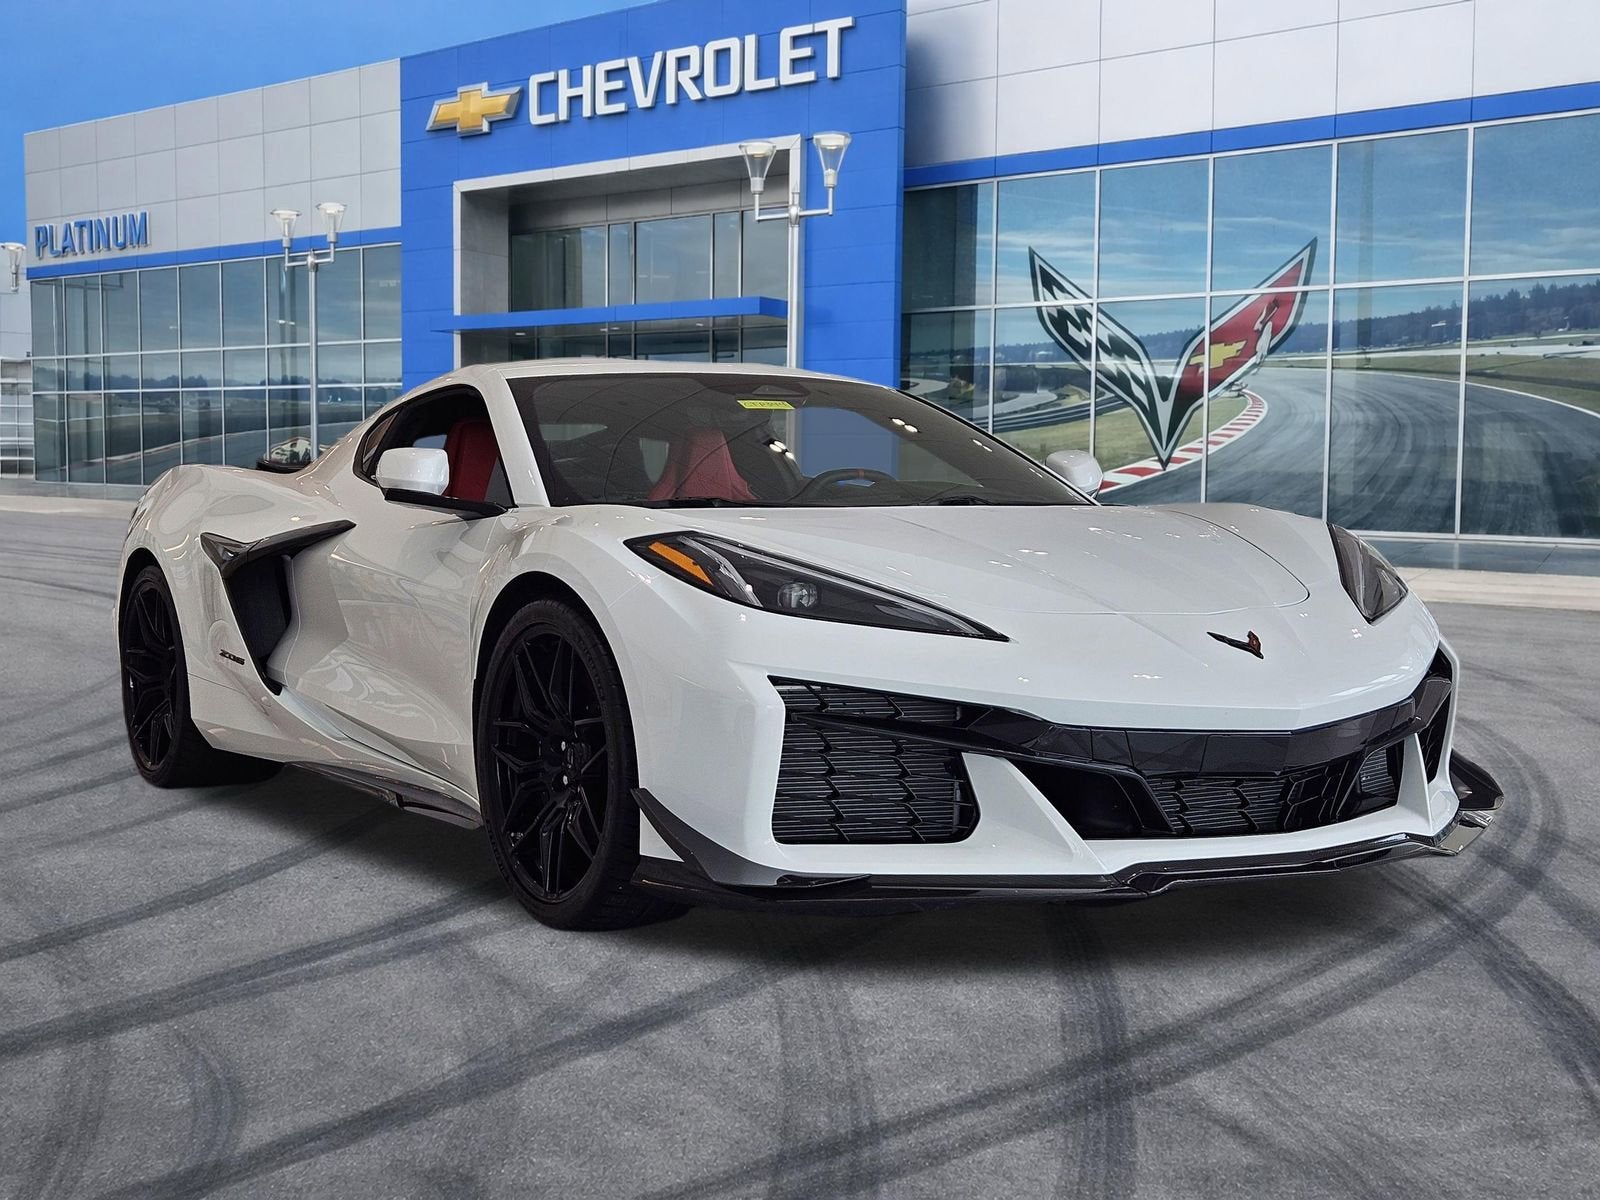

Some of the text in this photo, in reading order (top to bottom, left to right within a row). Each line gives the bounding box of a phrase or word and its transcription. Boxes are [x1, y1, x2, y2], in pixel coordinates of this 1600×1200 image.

[529, 16, 854, 126] CHEVROLET
[34, 211, 148, 259] PLATINUM
[219, 649, 245, 665] Z06
